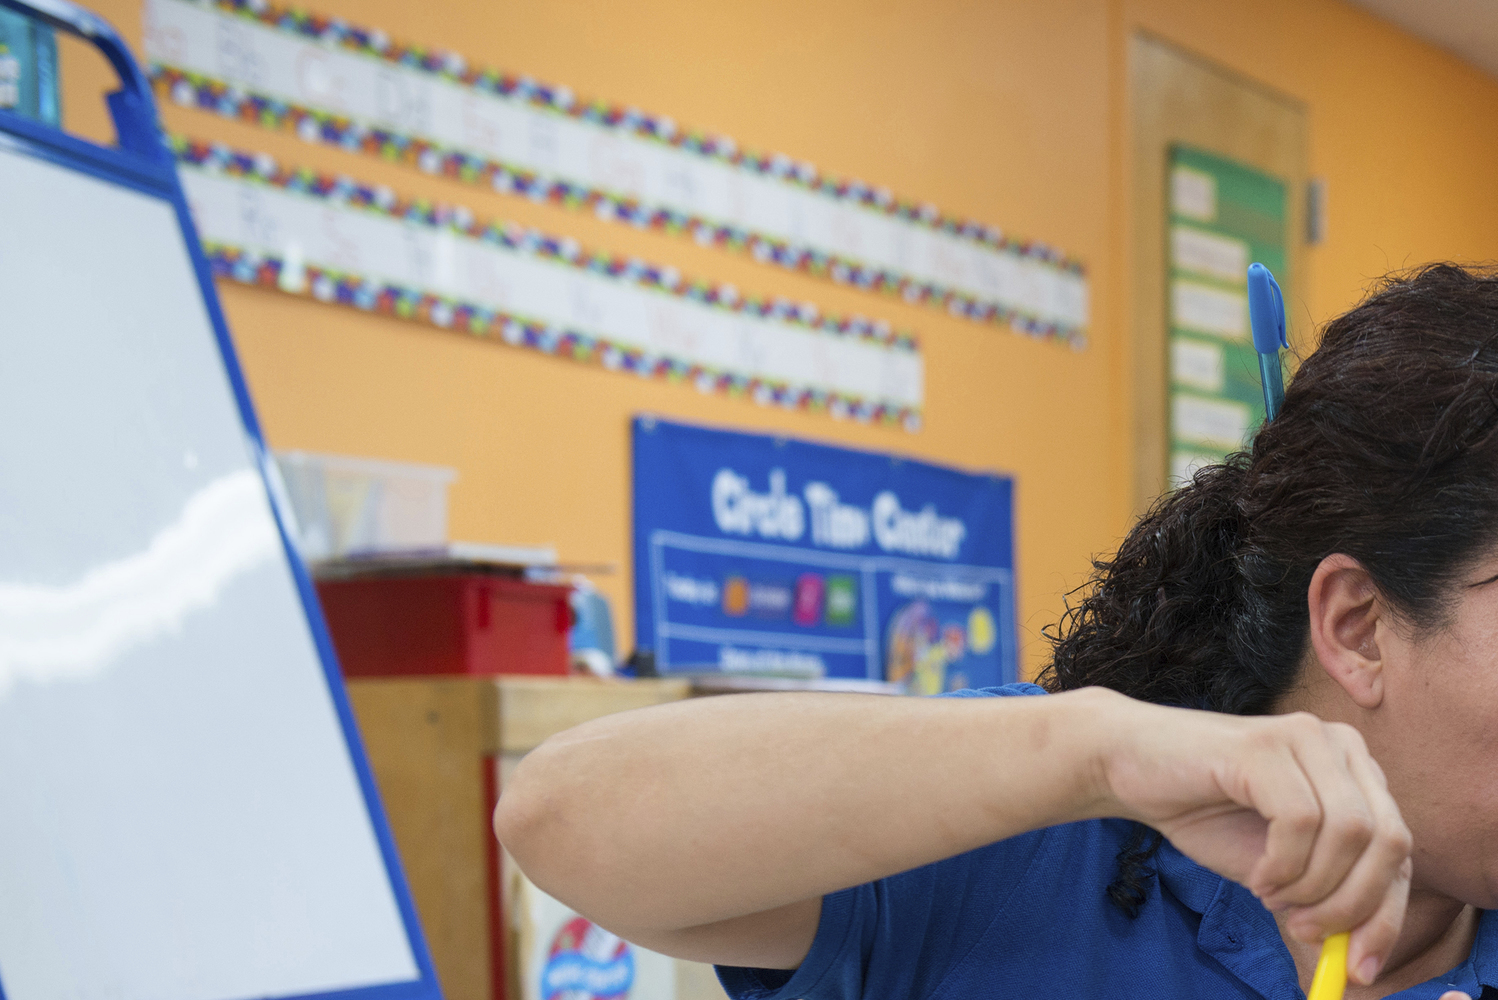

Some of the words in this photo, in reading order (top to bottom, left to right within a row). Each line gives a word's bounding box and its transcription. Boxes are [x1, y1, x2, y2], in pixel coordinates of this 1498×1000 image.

[712, 466, 805, 541] Circle
[803, 481, 872, 549] Time
[872, 490, 967, 560] Center
